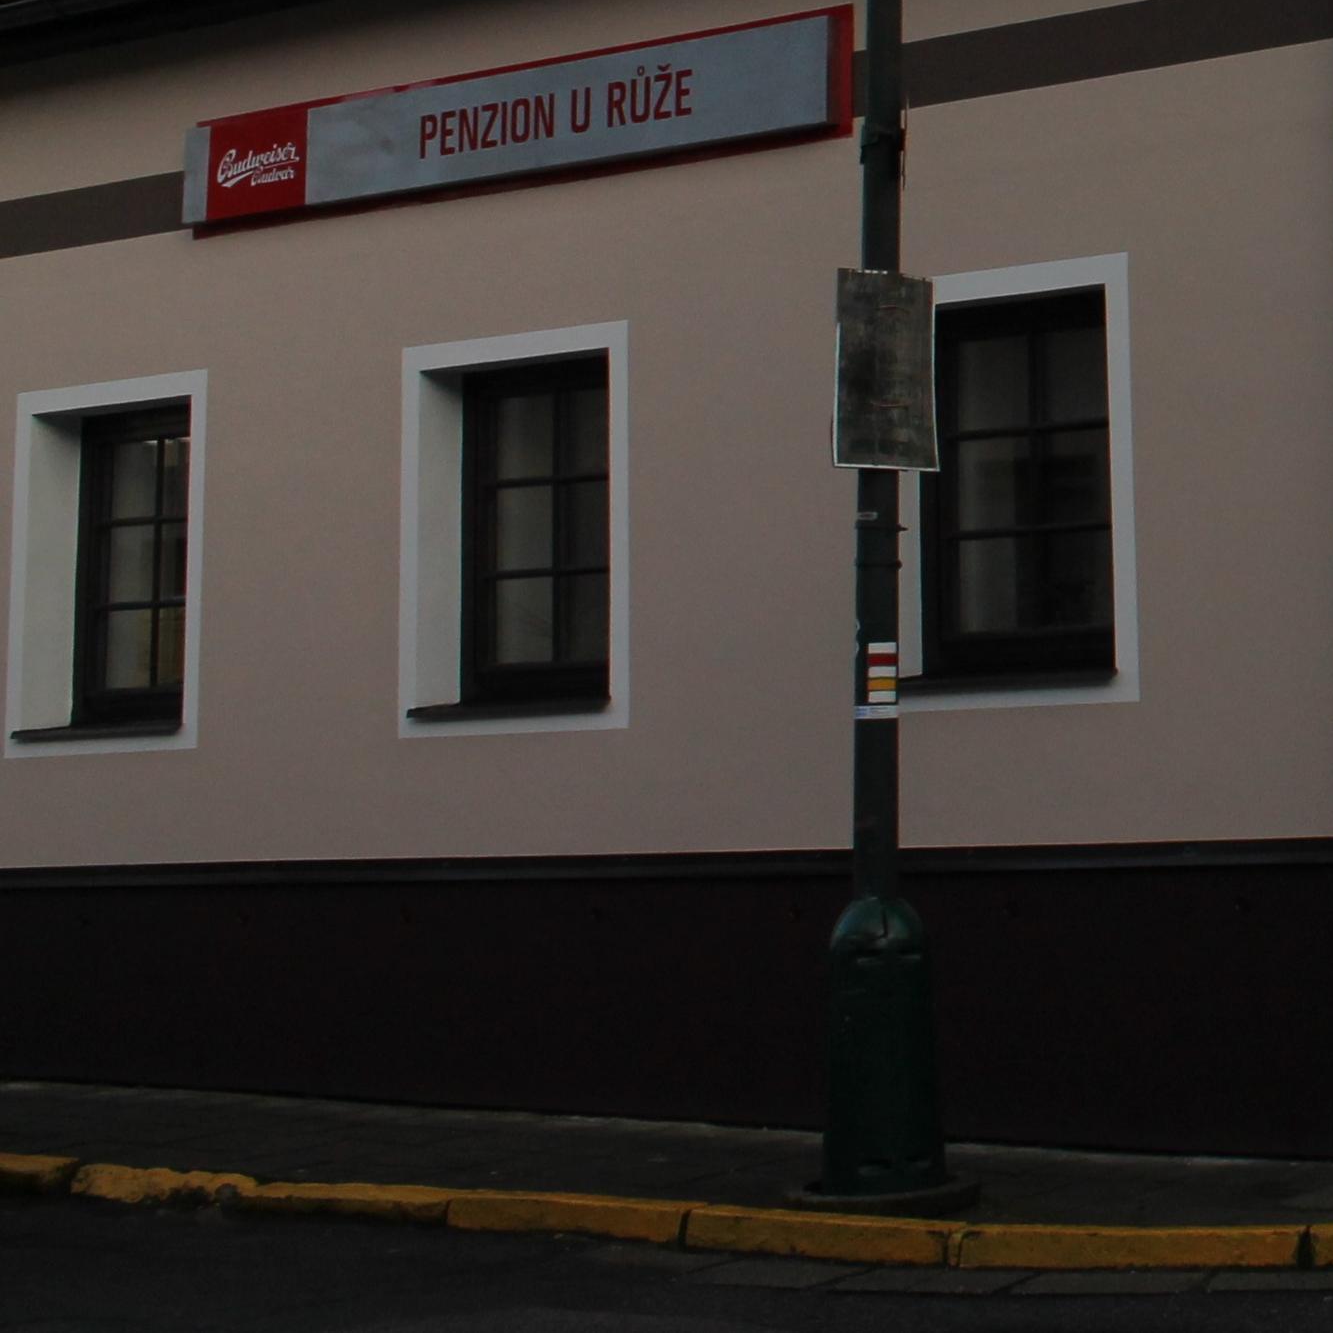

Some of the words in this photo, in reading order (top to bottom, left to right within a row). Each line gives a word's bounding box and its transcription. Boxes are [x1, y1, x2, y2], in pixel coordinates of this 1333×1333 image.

[419, 93, 556, 159] PENZION
[570, 87, 593, 134] U
[606, 62, 694, 129] RŮŽE
[217, 142, 300, 185] Budweiser
[250, 166, 295, 187] Budvar
